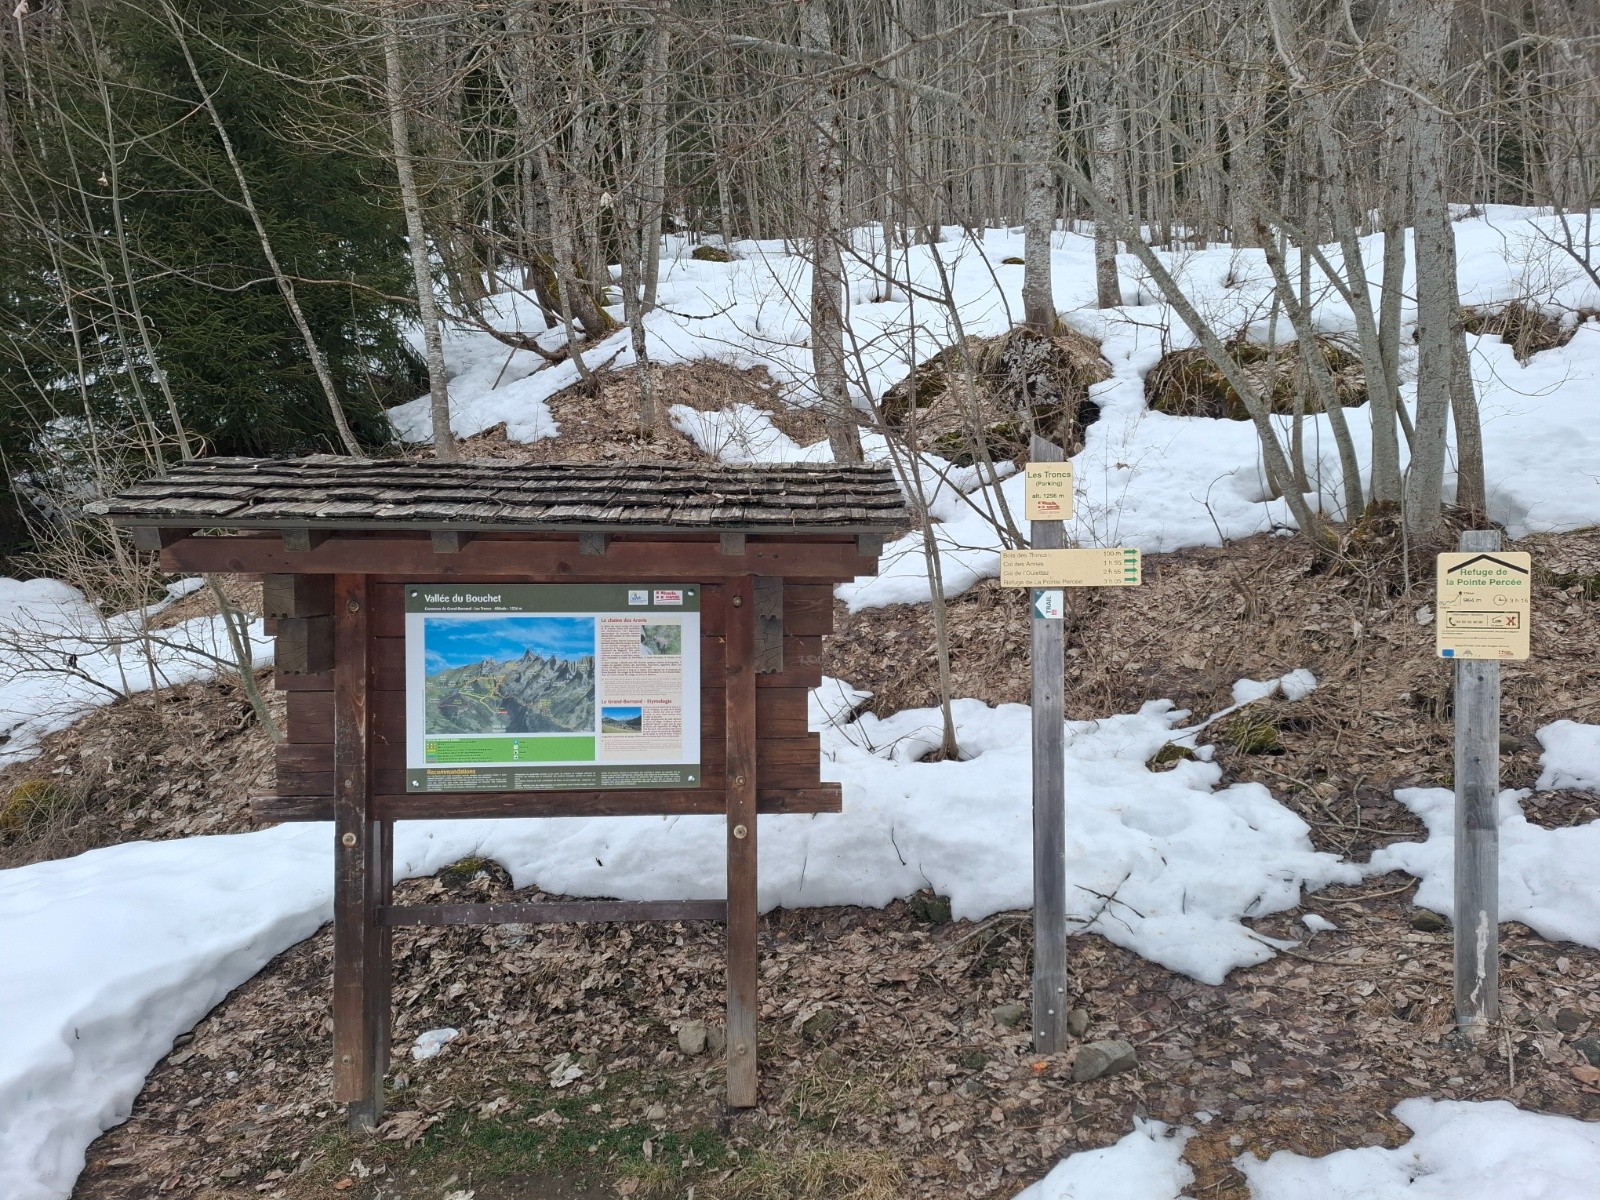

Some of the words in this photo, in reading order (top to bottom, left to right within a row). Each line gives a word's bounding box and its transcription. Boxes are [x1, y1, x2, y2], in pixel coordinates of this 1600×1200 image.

[1460, 568, 1494, 576] Refuge
[424, 594, 450, 602] Vallée
[452, 594, 464, 602] du
[466, 594, 502, 602] Bouchet
